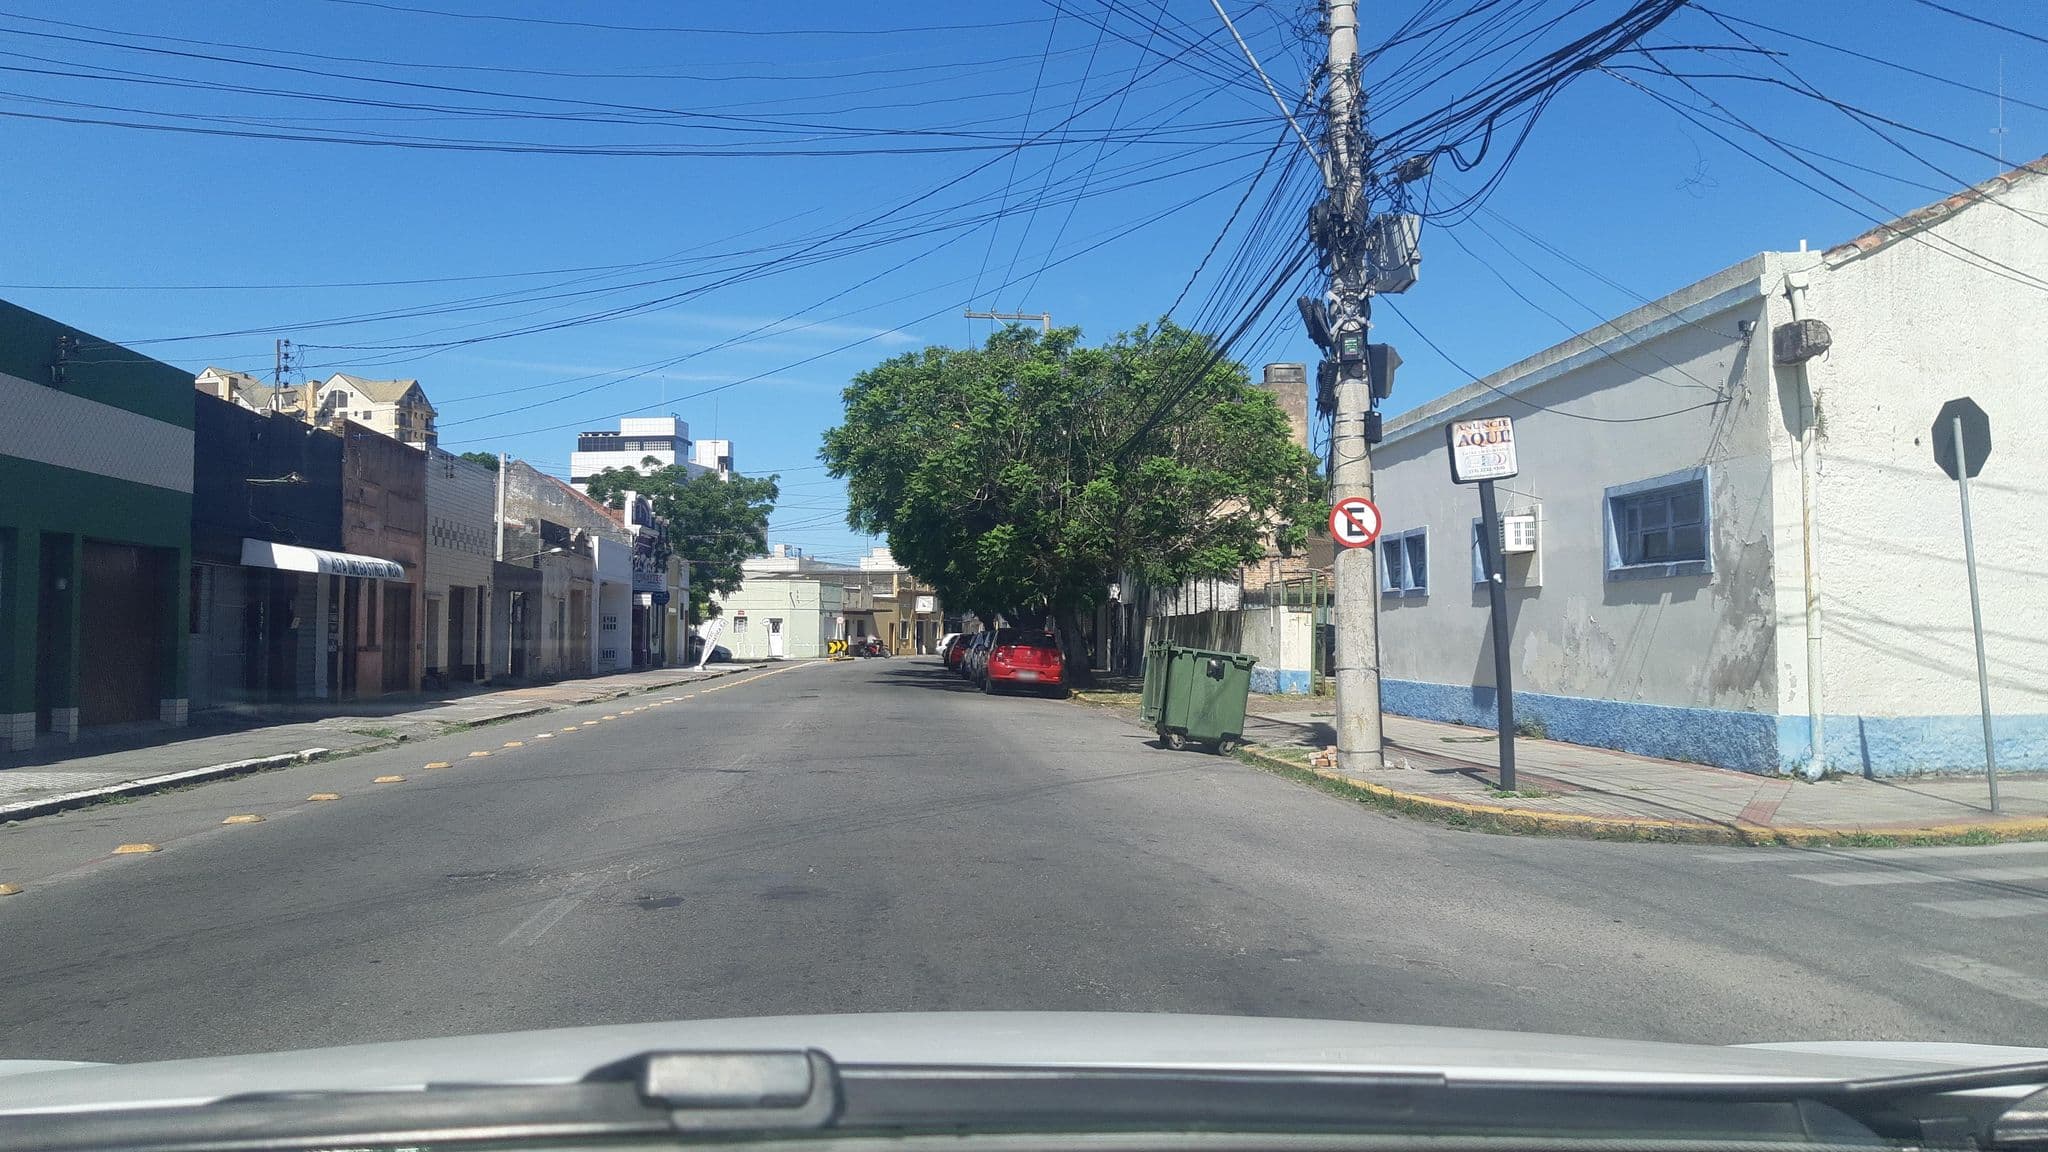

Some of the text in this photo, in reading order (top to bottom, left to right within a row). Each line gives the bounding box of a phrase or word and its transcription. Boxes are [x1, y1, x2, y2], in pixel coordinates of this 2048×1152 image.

[1456, 420, 1509, 431] ANUNCIE
[1347, 507, 1365, 536] E
[332, 558, 347, 574] ALFA
